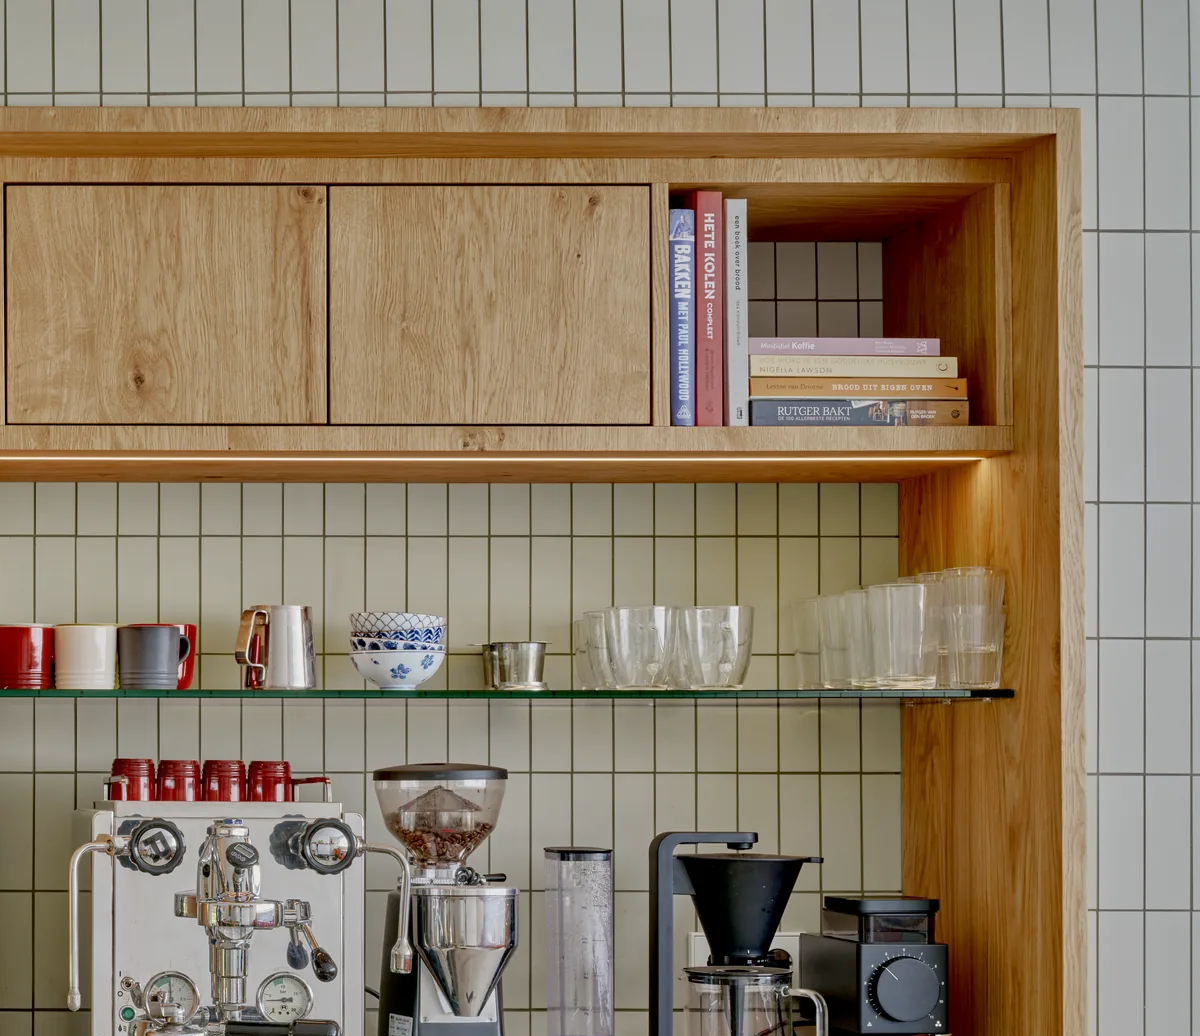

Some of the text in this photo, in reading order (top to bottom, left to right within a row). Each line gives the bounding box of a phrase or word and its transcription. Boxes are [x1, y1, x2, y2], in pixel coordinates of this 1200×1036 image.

[704, 213, 715, 248] HETE
[704, 253, 715, 299] KOLEN
[674, 244, 691, 400] BAKKEN MET PAUL HOLLYWOOD
[792, 342, 815, 350] Koffie
[777, 406, 852, 416] RUTGER BAKT
